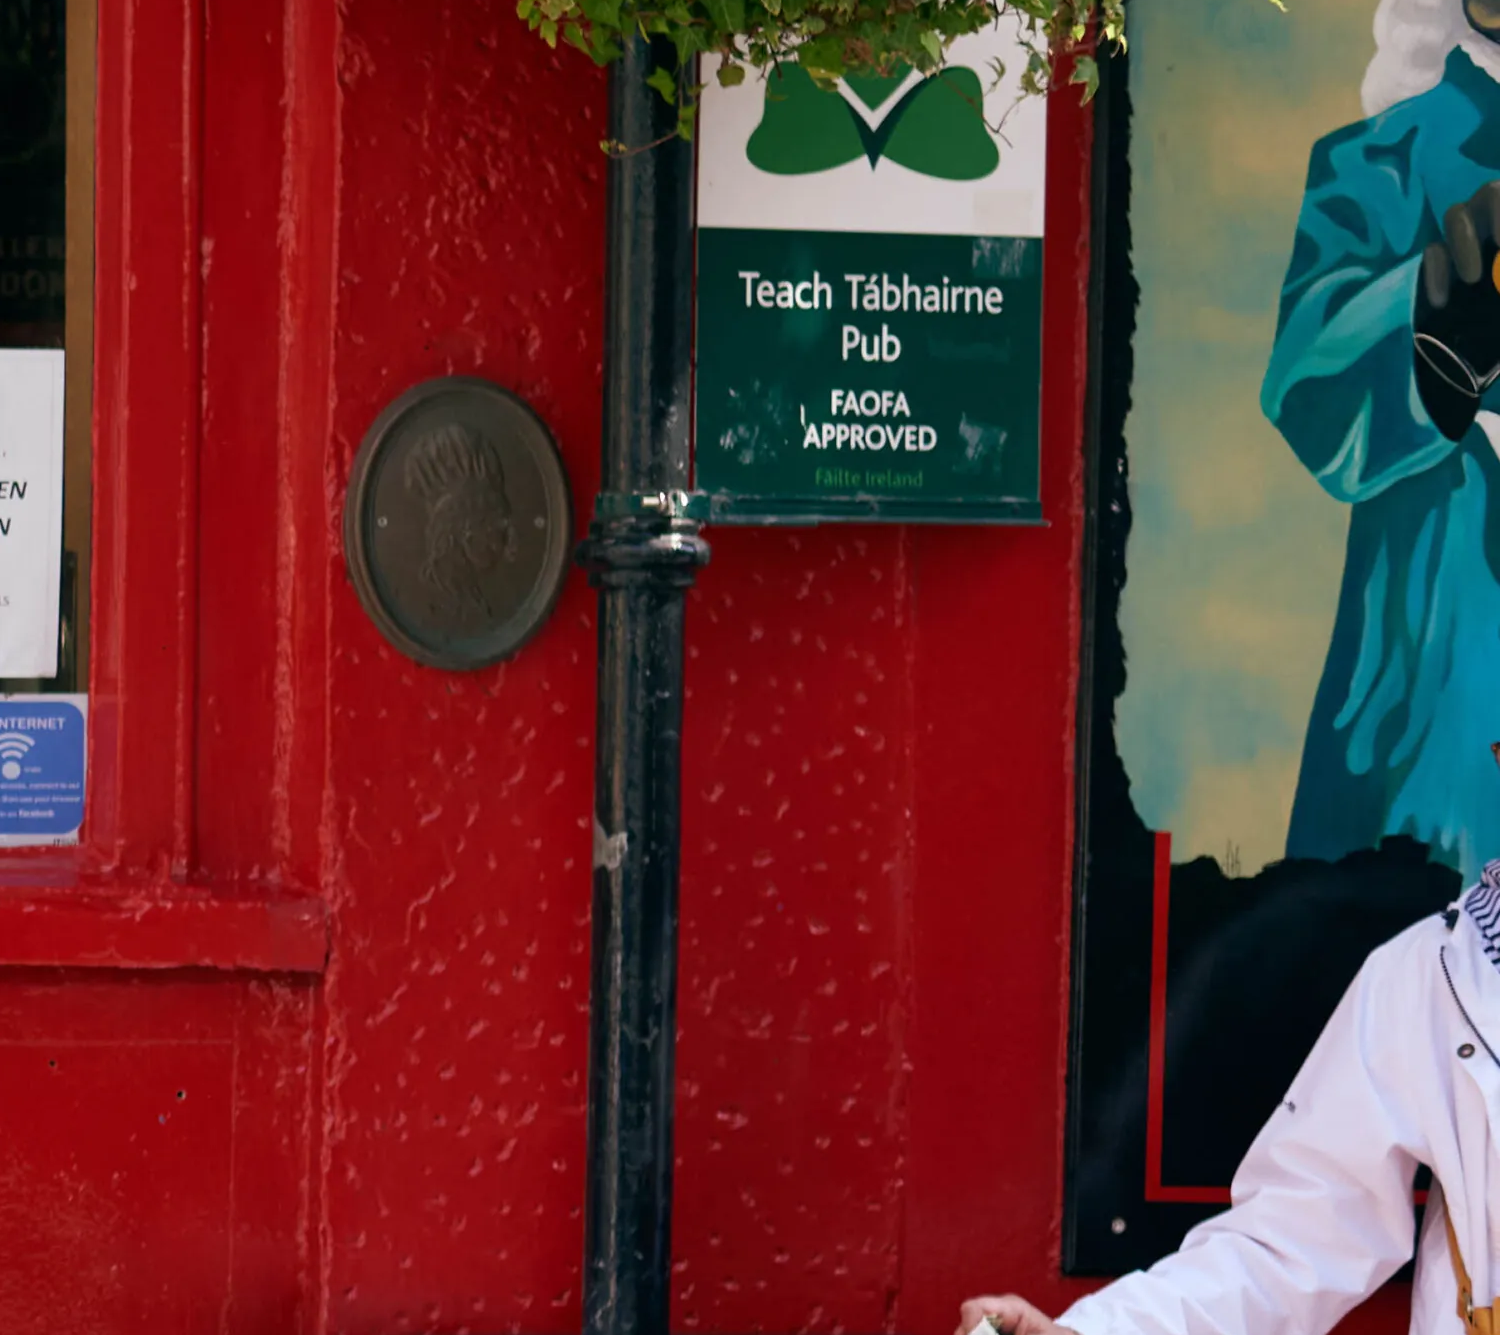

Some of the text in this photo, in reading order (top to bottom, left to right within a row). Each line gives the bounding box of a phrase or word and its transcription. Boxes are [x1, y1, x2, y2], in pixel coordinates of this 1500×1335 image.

[739, 271, 1002, 314] Teach Tábhairne
[842, 324, 901, 362] Pub
[831, 390, 910, 417] FAOFA
[803, 425, 937, 451] APPROVED
